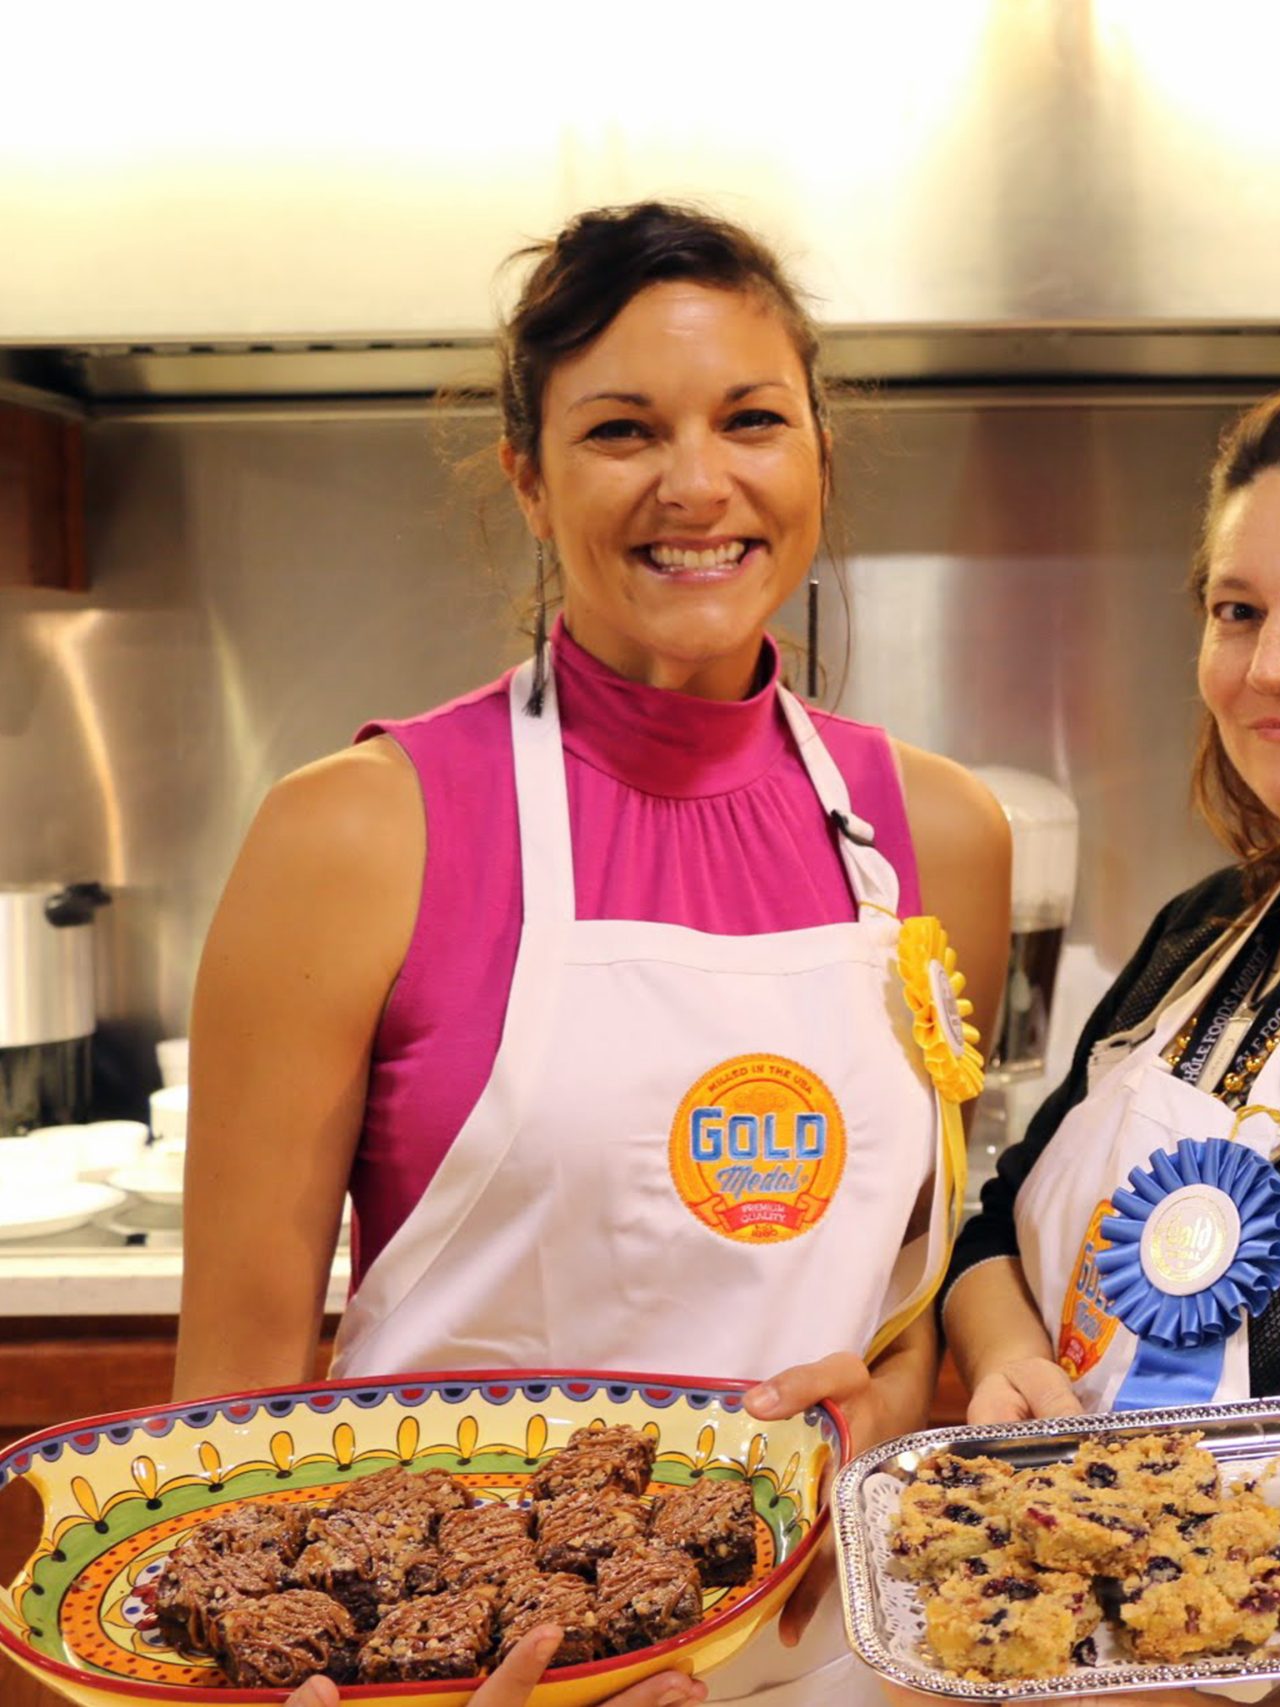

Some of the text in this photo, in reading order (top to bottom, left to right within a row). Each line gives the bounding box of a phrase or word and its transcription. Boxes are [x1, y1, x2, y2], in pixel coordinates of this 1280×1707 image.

[1180, 1043, 1213, 1083] HOLE
[1200, 996, 1239, 1045] FOODS
[691, 1107, 827, 1161] GOLD
[715, 1163, 804, 1200] Medal
